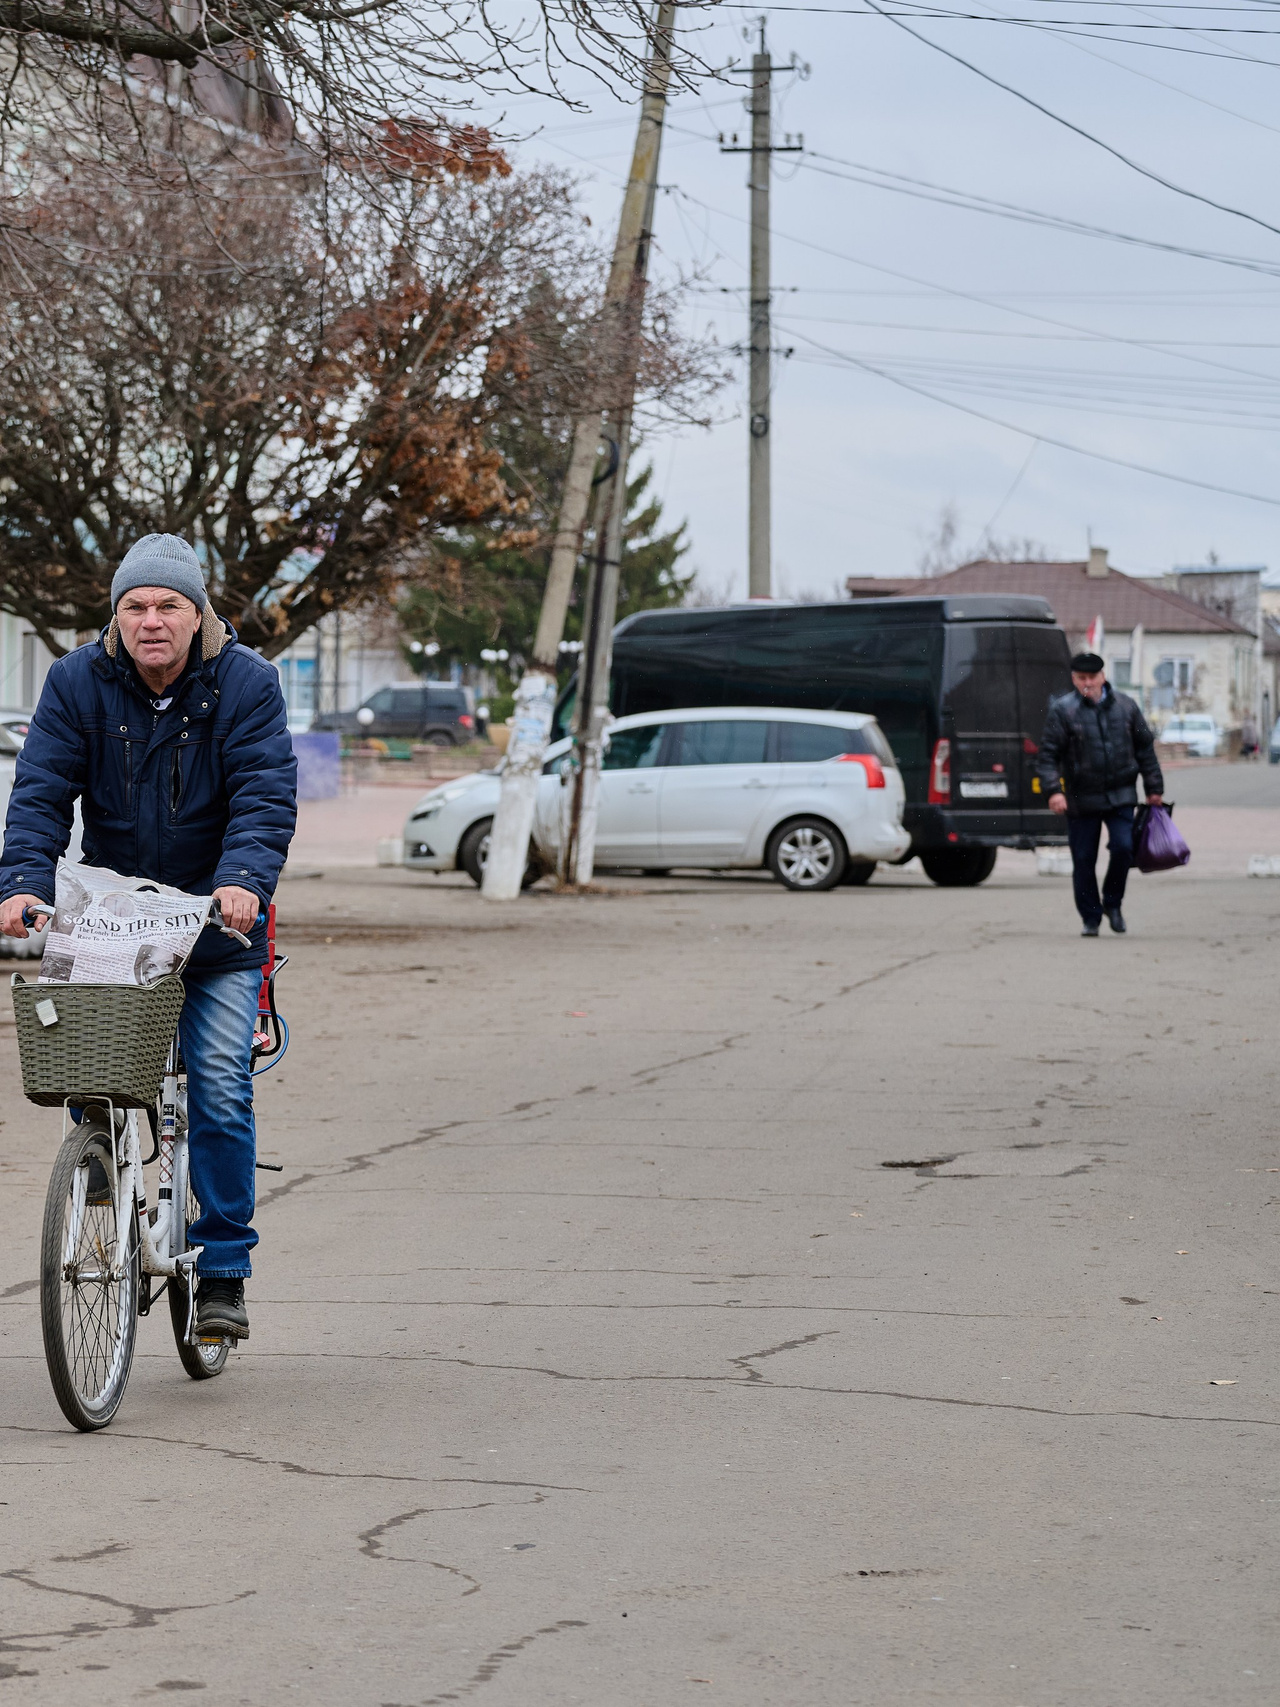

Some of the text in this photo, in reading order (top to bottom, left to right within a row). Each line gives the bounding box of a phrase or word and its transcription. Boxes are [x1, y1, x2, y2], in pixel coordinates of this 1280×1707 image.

[63, 911, 203, 933] SOUND THE SITY
[90, 928, 109, 938] Lonely
[186, 930, 197, 938] Guy
